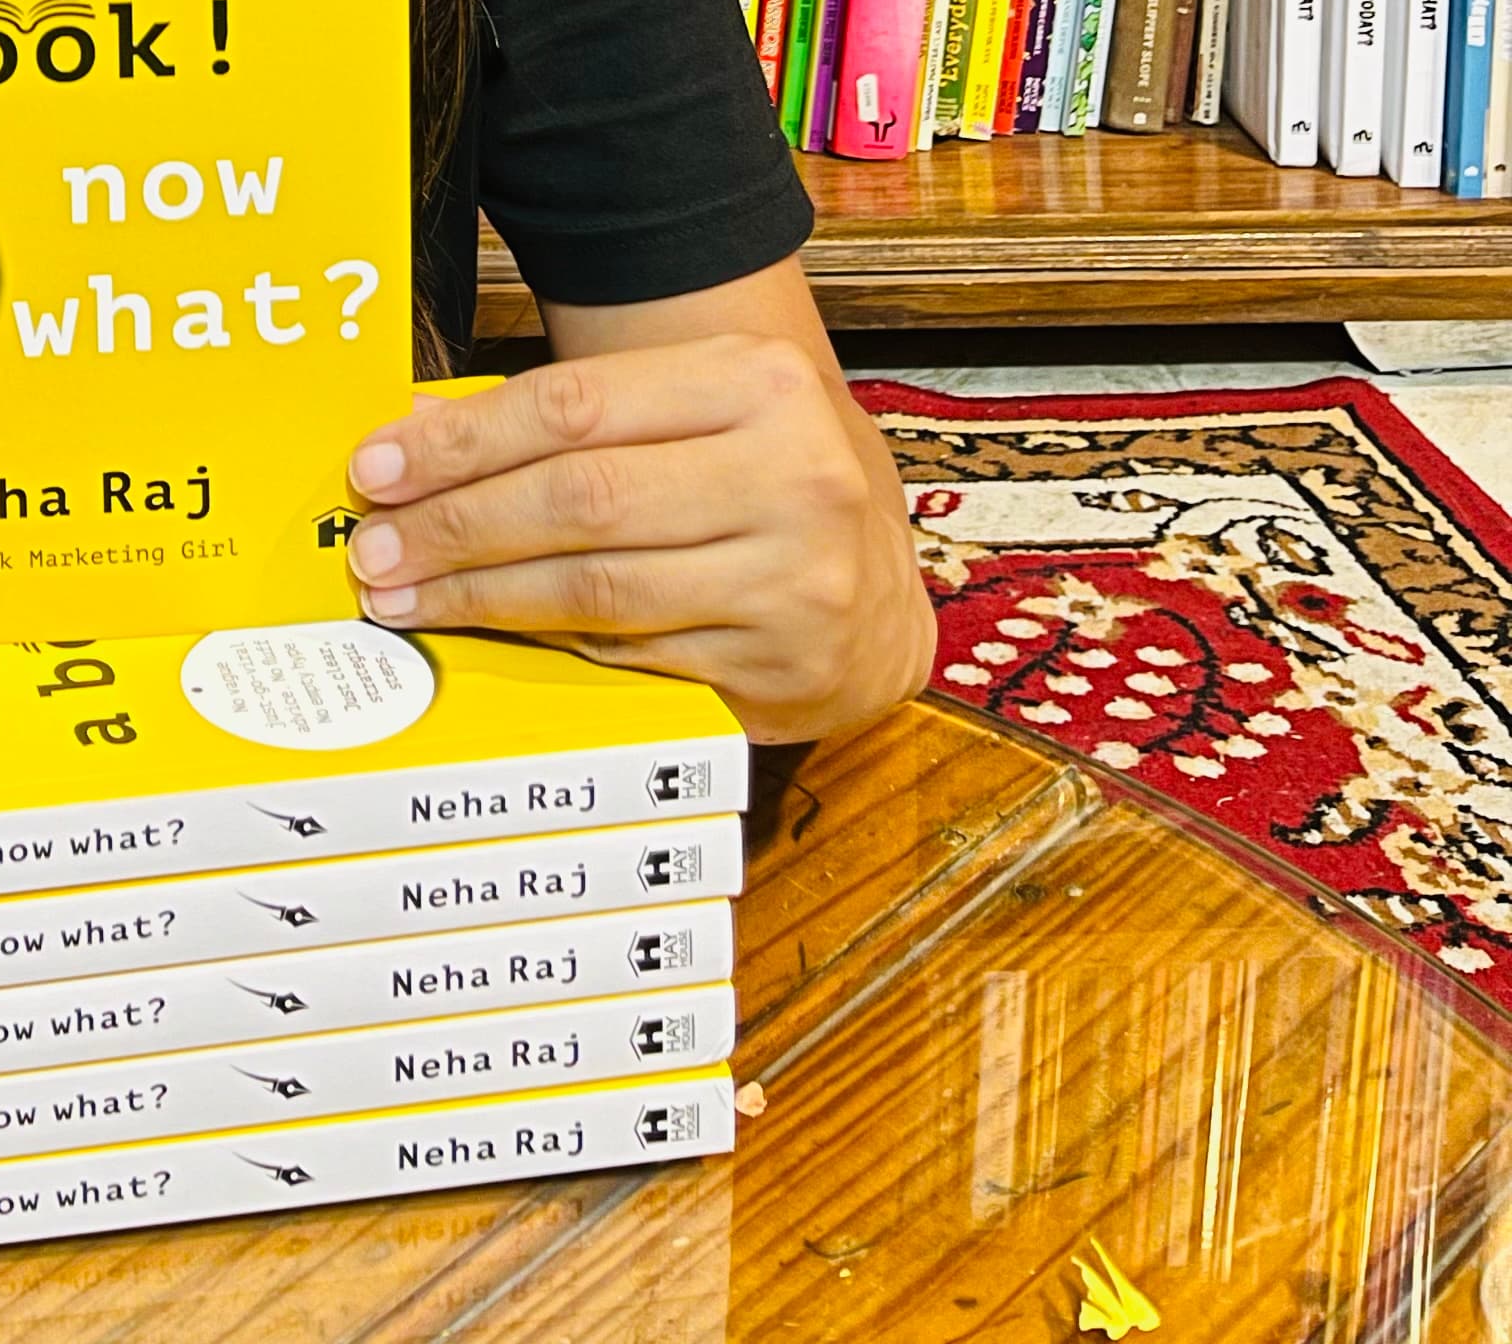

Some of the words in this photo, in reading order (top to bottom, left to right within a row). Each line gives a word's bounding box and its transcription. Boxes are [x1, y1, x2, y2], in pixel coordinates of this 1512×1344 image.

[62, 155, 284, 224] now
[13, 260, 381, 360] what?
[101, 465, 214, 521] Raj
[29, 543, 166, 569] Marketing
[181, 538, 239, 560] Girl
[410, 791, 508, 824] Neha
[527, 778, 599, 811] Raj
[69, 818, 186, 857] what?
[401, 877, 499, 911] Neha
[518, 864, 590, 897] Raj
[61, 910, 177, 949] what?
[392, 963, 490, 998] Neha
[509, 950, 580, 985] Raj
[50, 997, 166, 1036] what?
[394, 1048, 492, 1082] Neha
[511, 1034, 582, 1068] Raj
[53, 1083, 169, 1122] what?
[397, 1136, 496, 1171] Neha
[515, 1122, 586, 1157] Raj
[57, 1170, 172, 1208] what?
